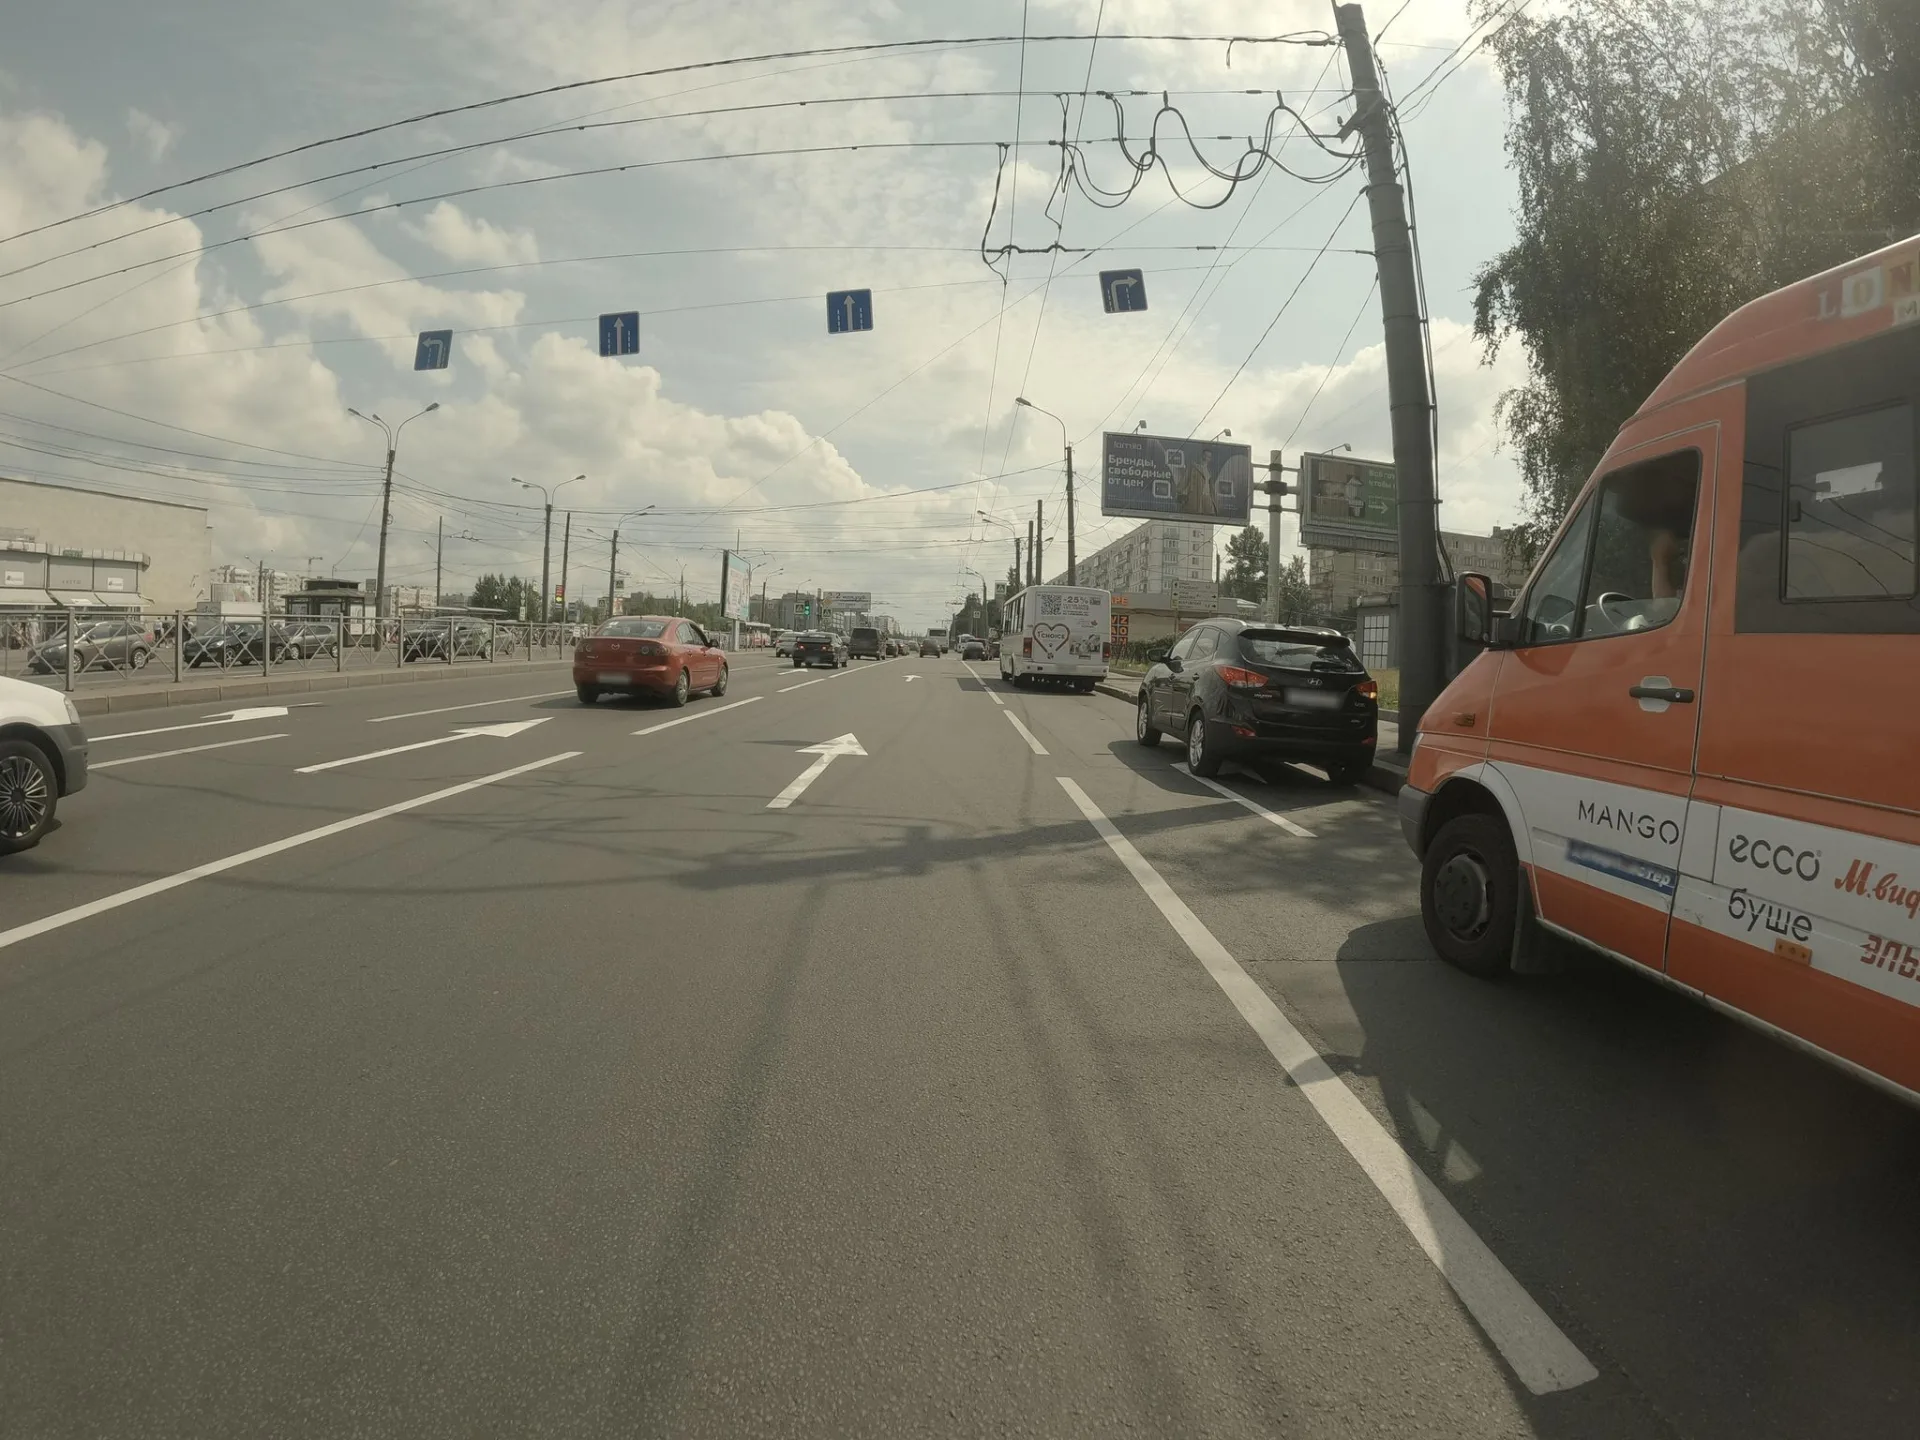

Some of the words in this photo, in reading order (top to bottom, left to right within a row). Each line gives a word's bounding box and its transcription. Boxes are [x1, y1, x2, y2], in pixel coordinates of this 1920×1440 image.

[1818, 258, 1920, 320] LON
[1108, 454, 1157, 469] Бренды,
[1108, 465, 1171, 479] свободные
[1108, 476, 1121, 485] от
[1123, 479, 1144, 488] цен
[1578, 799, 1679, 845] MANGO
[1729, 834, 1820, 881] ecco
[1728, 888, 1813, 942] буше
[1860, 934, 1920, 983] ЭЛЬ
